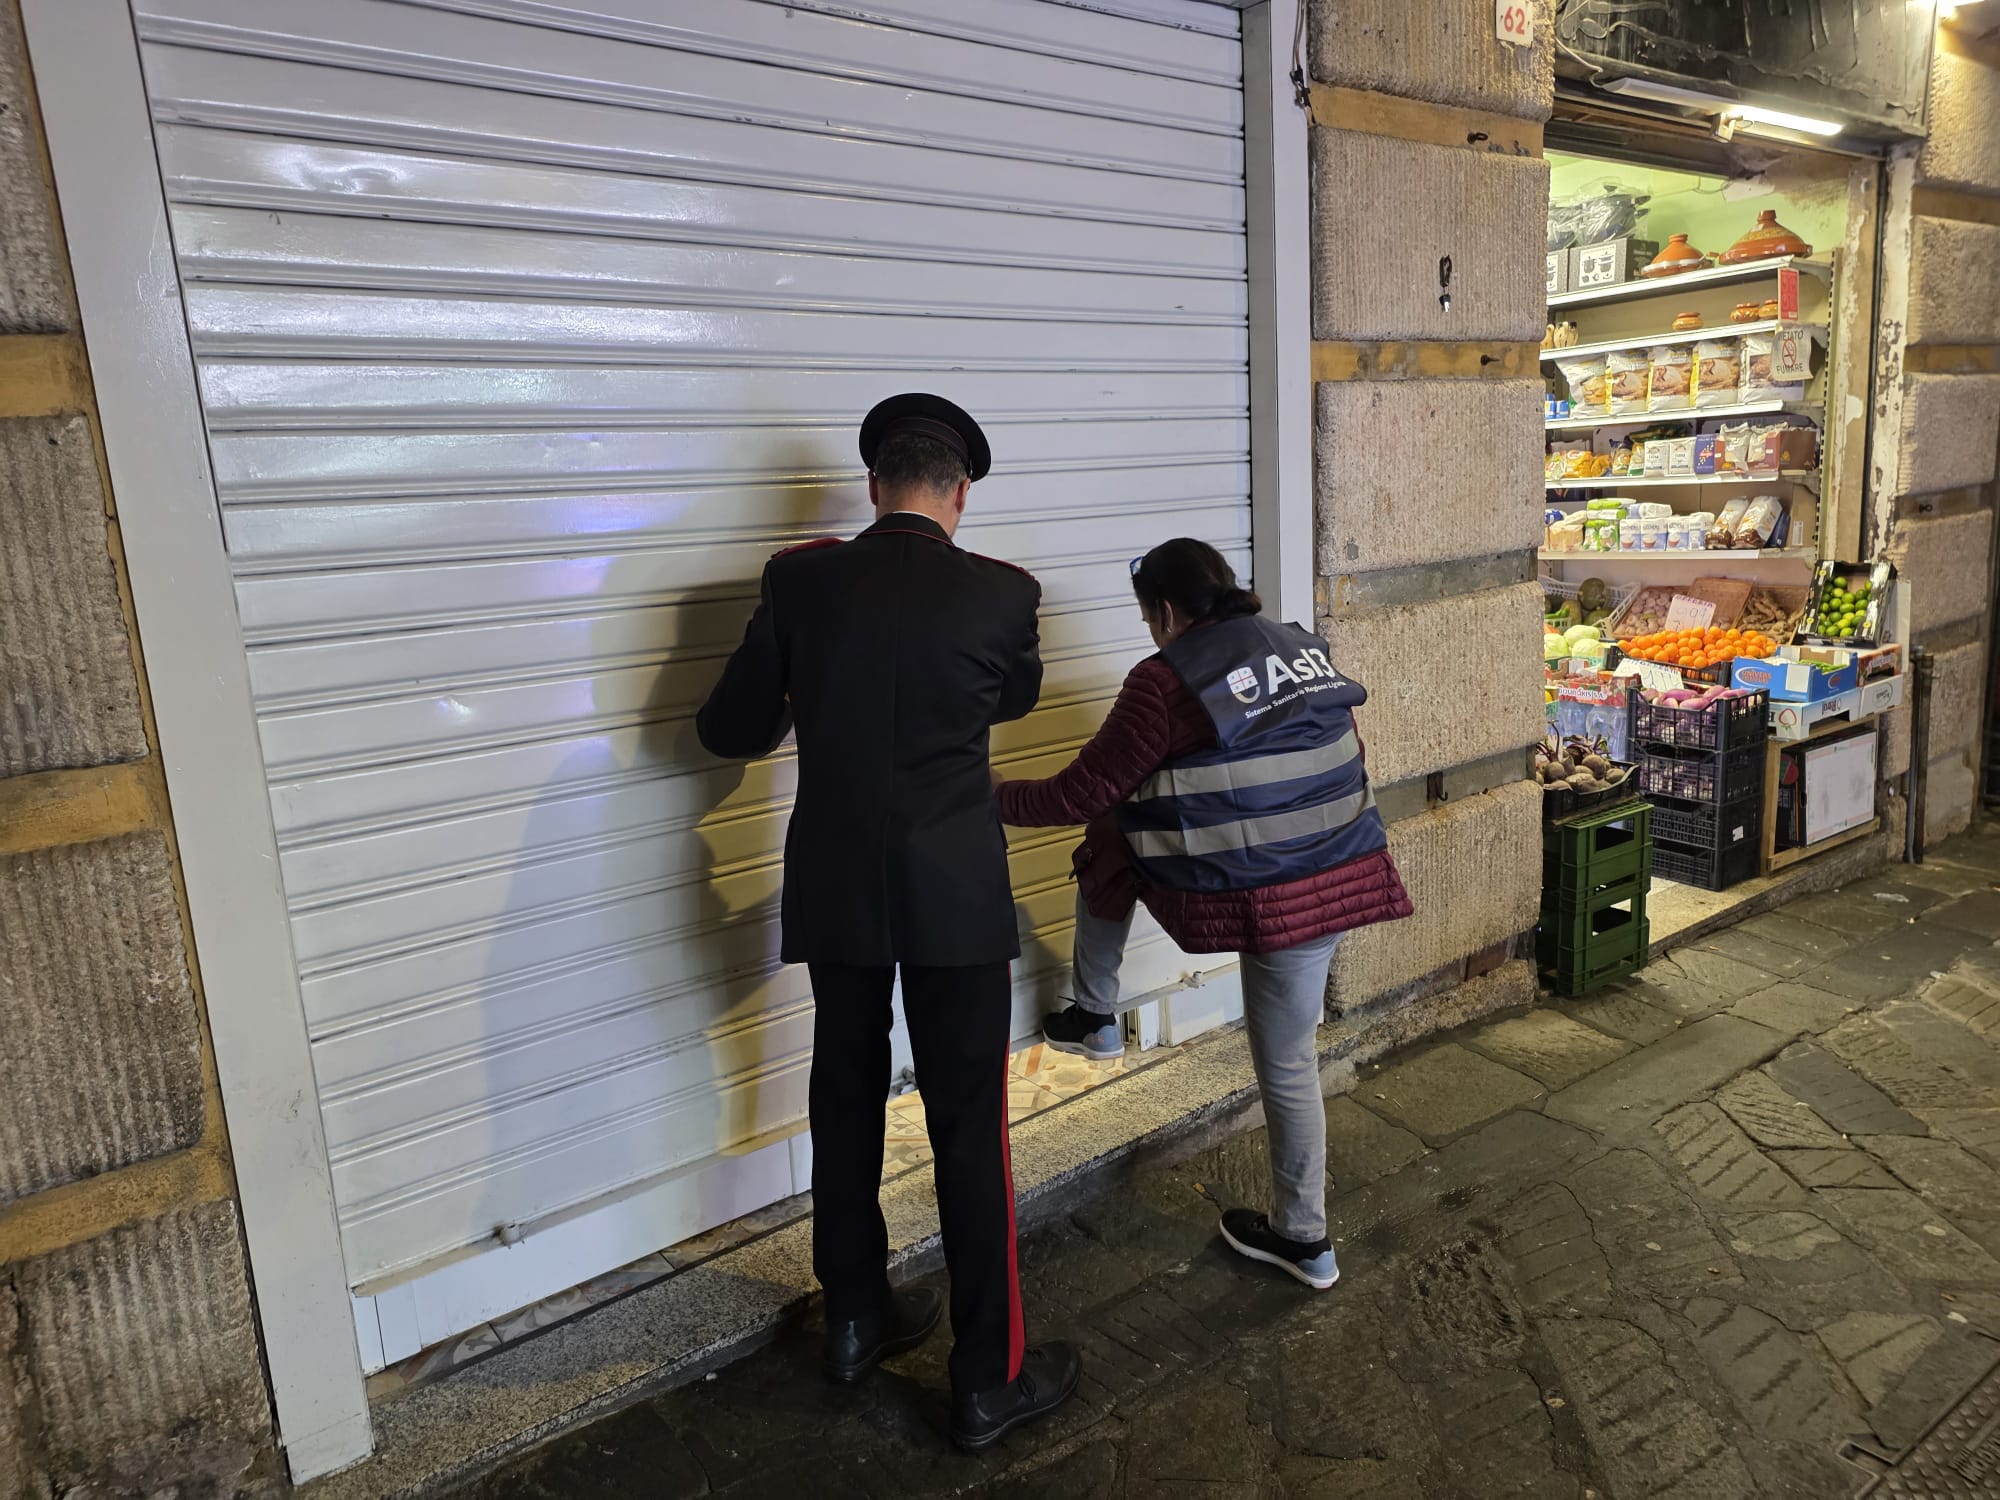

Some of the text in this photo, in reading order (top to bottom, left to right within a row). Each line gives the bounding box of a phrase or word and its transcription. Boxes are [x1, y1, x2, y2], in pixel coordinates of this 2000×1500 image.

[1504, 6, 1525, 35] 62
[1266, 648, 1335, 695] Asl3
[1245, 704, 1272, 719] Sistema
[1272, 688, 1305, 707] Sanitario
[1304, 684, 1328, 693] Regione
